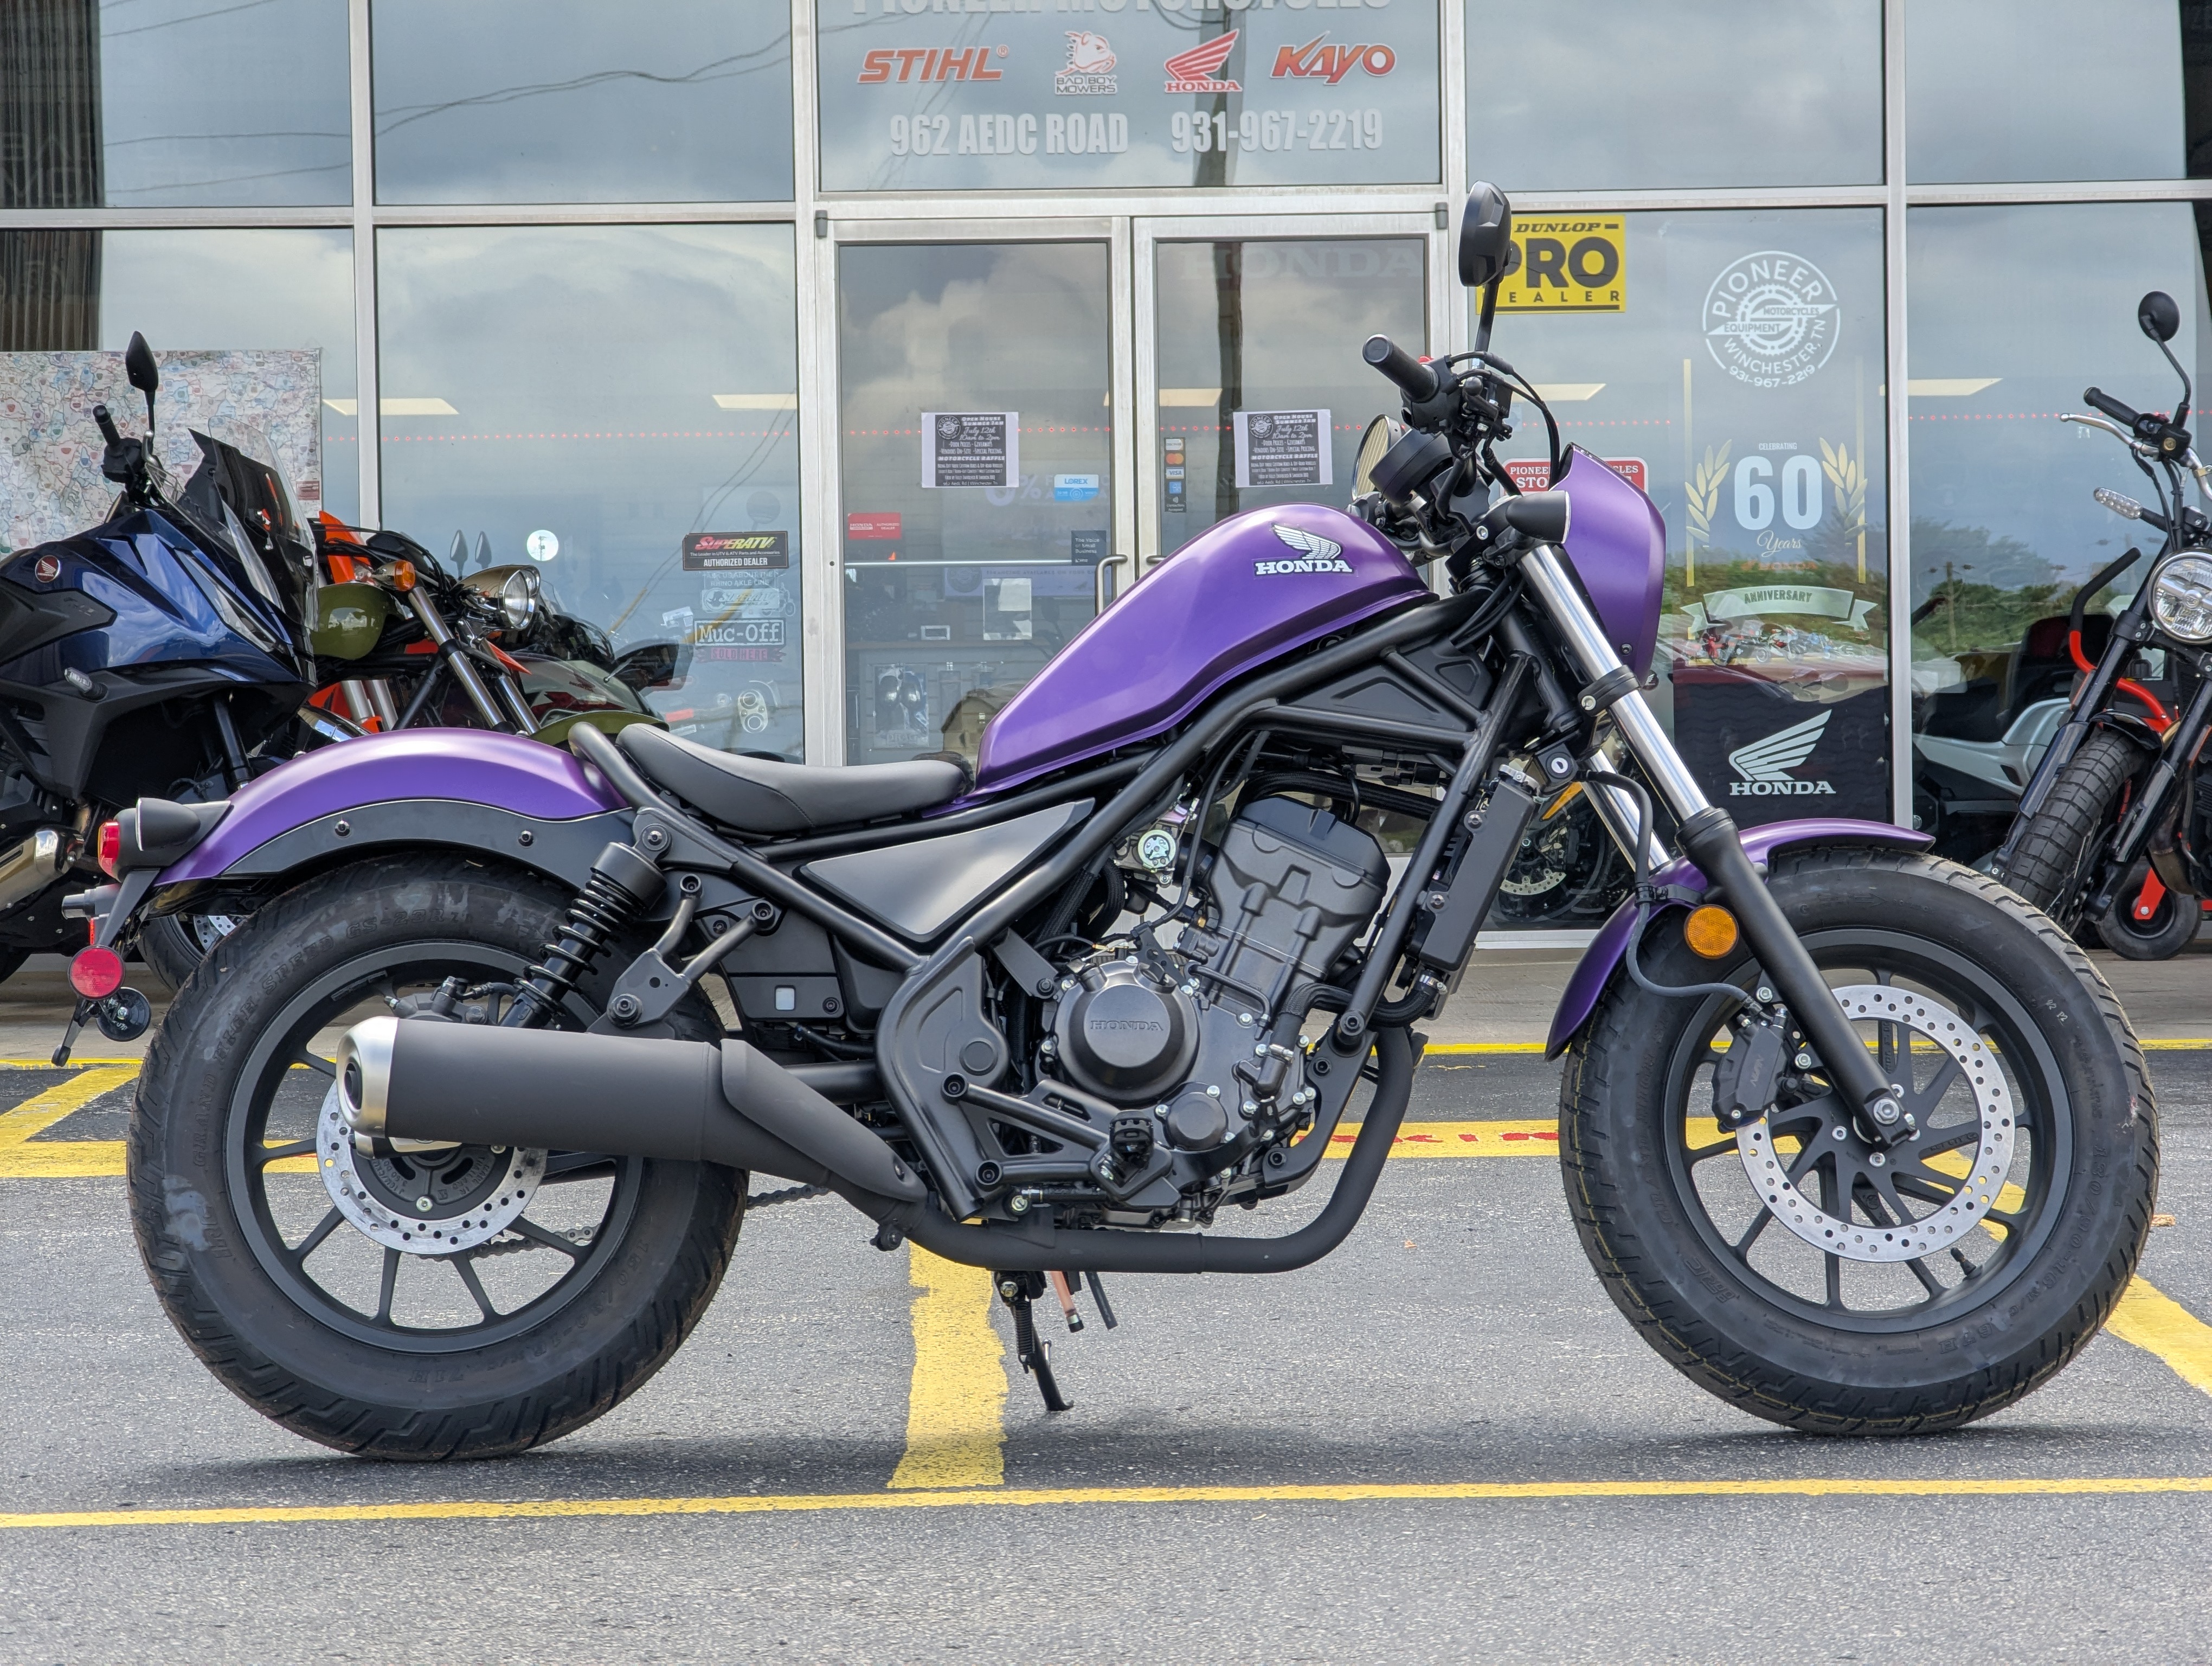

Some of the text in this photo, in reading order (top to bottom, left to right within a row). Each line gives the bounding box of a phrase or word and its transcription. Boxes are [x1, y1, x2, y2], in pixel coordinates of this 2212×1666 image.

[1270, 31, 1396, 85] KAYO
[857, 47, 1003, 84] STIHL
[1057, 85, 1116, 93] MOWERS
[1165, 81, 1242, 93] HONDA
[890, 113, 1128, 155] 962 AEDC ROAD
[1171, 108, 1382, 153] 931-967-2219
[1514, 223, 1600, 233] DUNLOP
[1180, 247, 1423, 279] HONDA
[1712, 260, 1822, 318] PIONEER
[1483, 291, 1619, 303] EALER
[1763, 307, 1819, 316] MOTORCYCLES
[1724, 323, 1780, 332] EQUIPMENT
[1811, 319, 1826, 339] TN
[1729, 364, 1815, 388] 931-967-2219
[938, 417, 958, 427] PIONEER
[1251, 415, 1270, 427] PIONEER
[963, 427, 980, 436] July
[1276, 425, 1292, 434] July
[1298, 432, 1313, 440] 2pm
[986, 434, 1000, 442] 2pm
[1510, 466, 1549, 475] PIONEE
[1734, 455, 1822, 530] 60
[1757, 530, 1802, 557] Years
[704, 558, 767, 567] AUTHORIZED DEALER
[1256, 559, 1352, 575] HONDA
[1744, 589, 1812, 604] ANNIVERSARY
[699, 623, 780, 643] Muc-Off
[1729, 781, 1836, 796] HONDA
[258, 933, 337, 996] SPEED
[1090, 1021, 1163, 1031] HONDA
